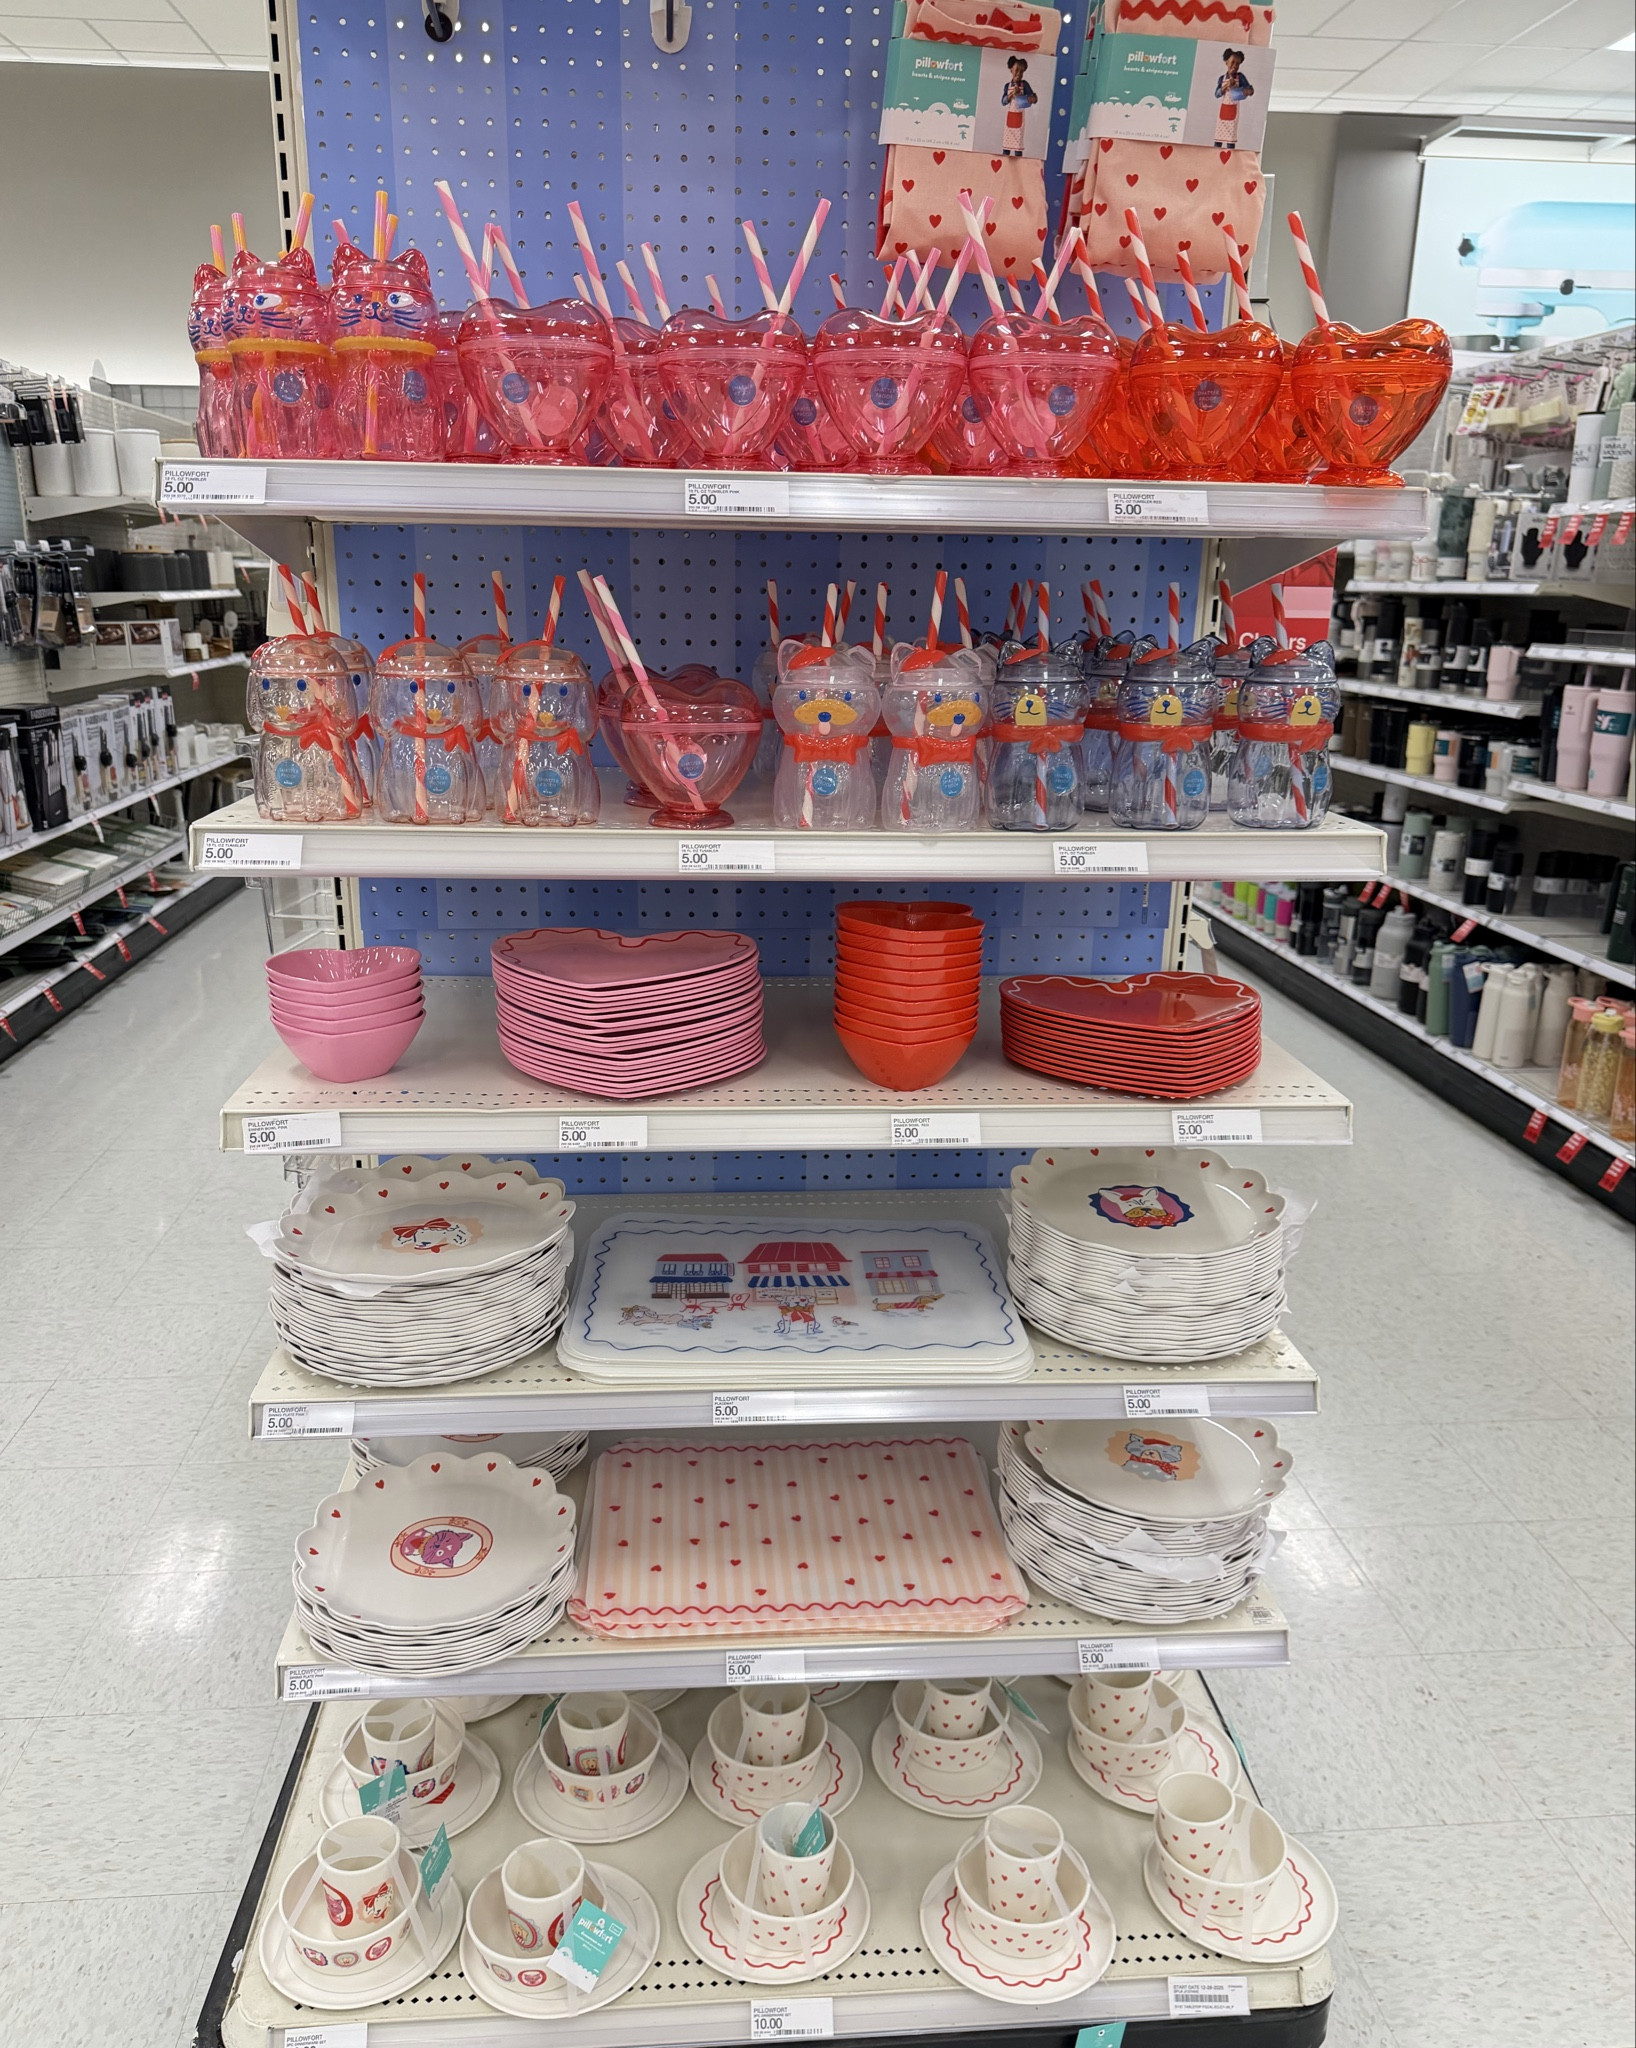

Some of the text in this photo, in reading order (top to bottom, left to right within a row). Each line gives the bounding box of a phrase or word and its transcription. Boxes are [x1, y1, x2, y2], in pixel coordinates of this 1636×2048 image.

[1127, 50, 1176, 65] pillowfort
[915, 56, 963, 72] pillowfort
[164, 482, 193, 493] 5.00
[689, 494, 716, 505] 5.00
[1114, 504, 1142, 515] 5.00
[1239, 632, 1306, 650] Crs
[205, 848, 233, 858] 5.00
[682, 853, 708, 864] 5.00
[1060, 856, 1085, 866] 5.00
[894, 1127, 918, 1138] 5.00
[1178, 1124, 1202, 1135] 5.00
[249, 1131, 276, 1143] 5.00
[561, 1131, 586, 1141] 5.00
[1128, 1399, 1150, 1408] 5.00
[715, 1406, 738, 1416] 5.00
[268, 1418, 293, 1428] 5.00
[1082, 1653, 1103, 1663] 5.00
[728, 1665, 750, 1675] 5.00
[290, 1679, 313, 1690] 5.00
[578, 1918, 613, 1944] pillowfort
[755, 2018, 782, 2029] 10.00
[287, 2034, 322, 2042] PILLOWFORT
